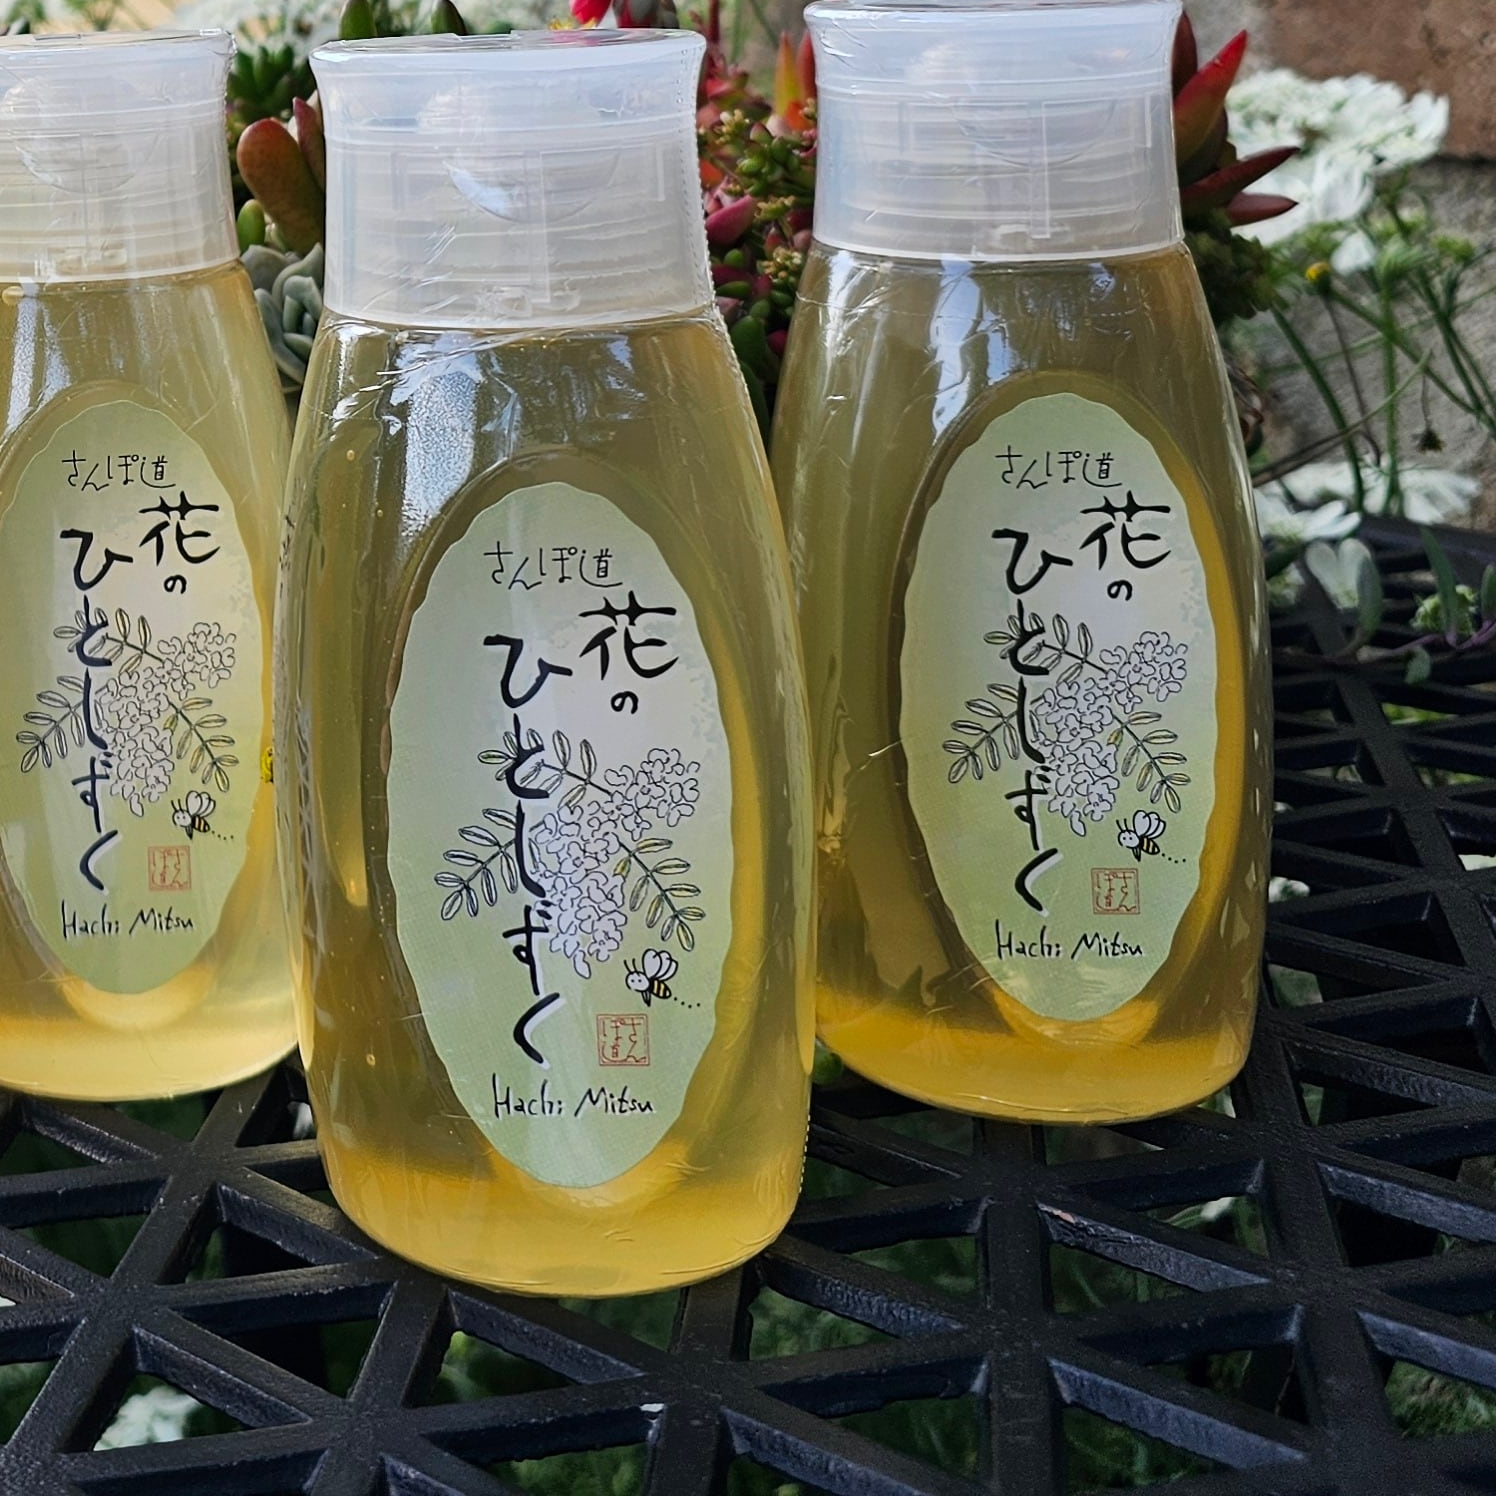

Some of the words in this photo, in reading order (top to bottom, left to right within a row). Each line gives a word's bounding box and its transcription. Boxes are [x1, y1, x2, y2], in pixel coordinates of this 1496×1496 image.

[61, 450, 176, 491] さんぽ道
[995, 446, 1122, 490] さんぽ道
[139, 490, 221, 595] 花の
[483, 540, 623, 590] さんぽ道
[1081, 490, 1172, 601] 花の
[578, 590, 680, 714] 花の
[60, 528, 133, 891] ひとしずく
[992, 529, 1073, 912] ひとしずく
[483, 633, 573, 1063] ひとしずく
[61, 900, 120, 938] Hachi
[128, 901, 194, 935] Mitsu
[995, 920, 1061, 959] Hachi
[1071, 922, 1143, 958] Mitsu
[492, 1073, 563, 1118] Hachi
[575, 1075, 653, 1117] Mitsu
